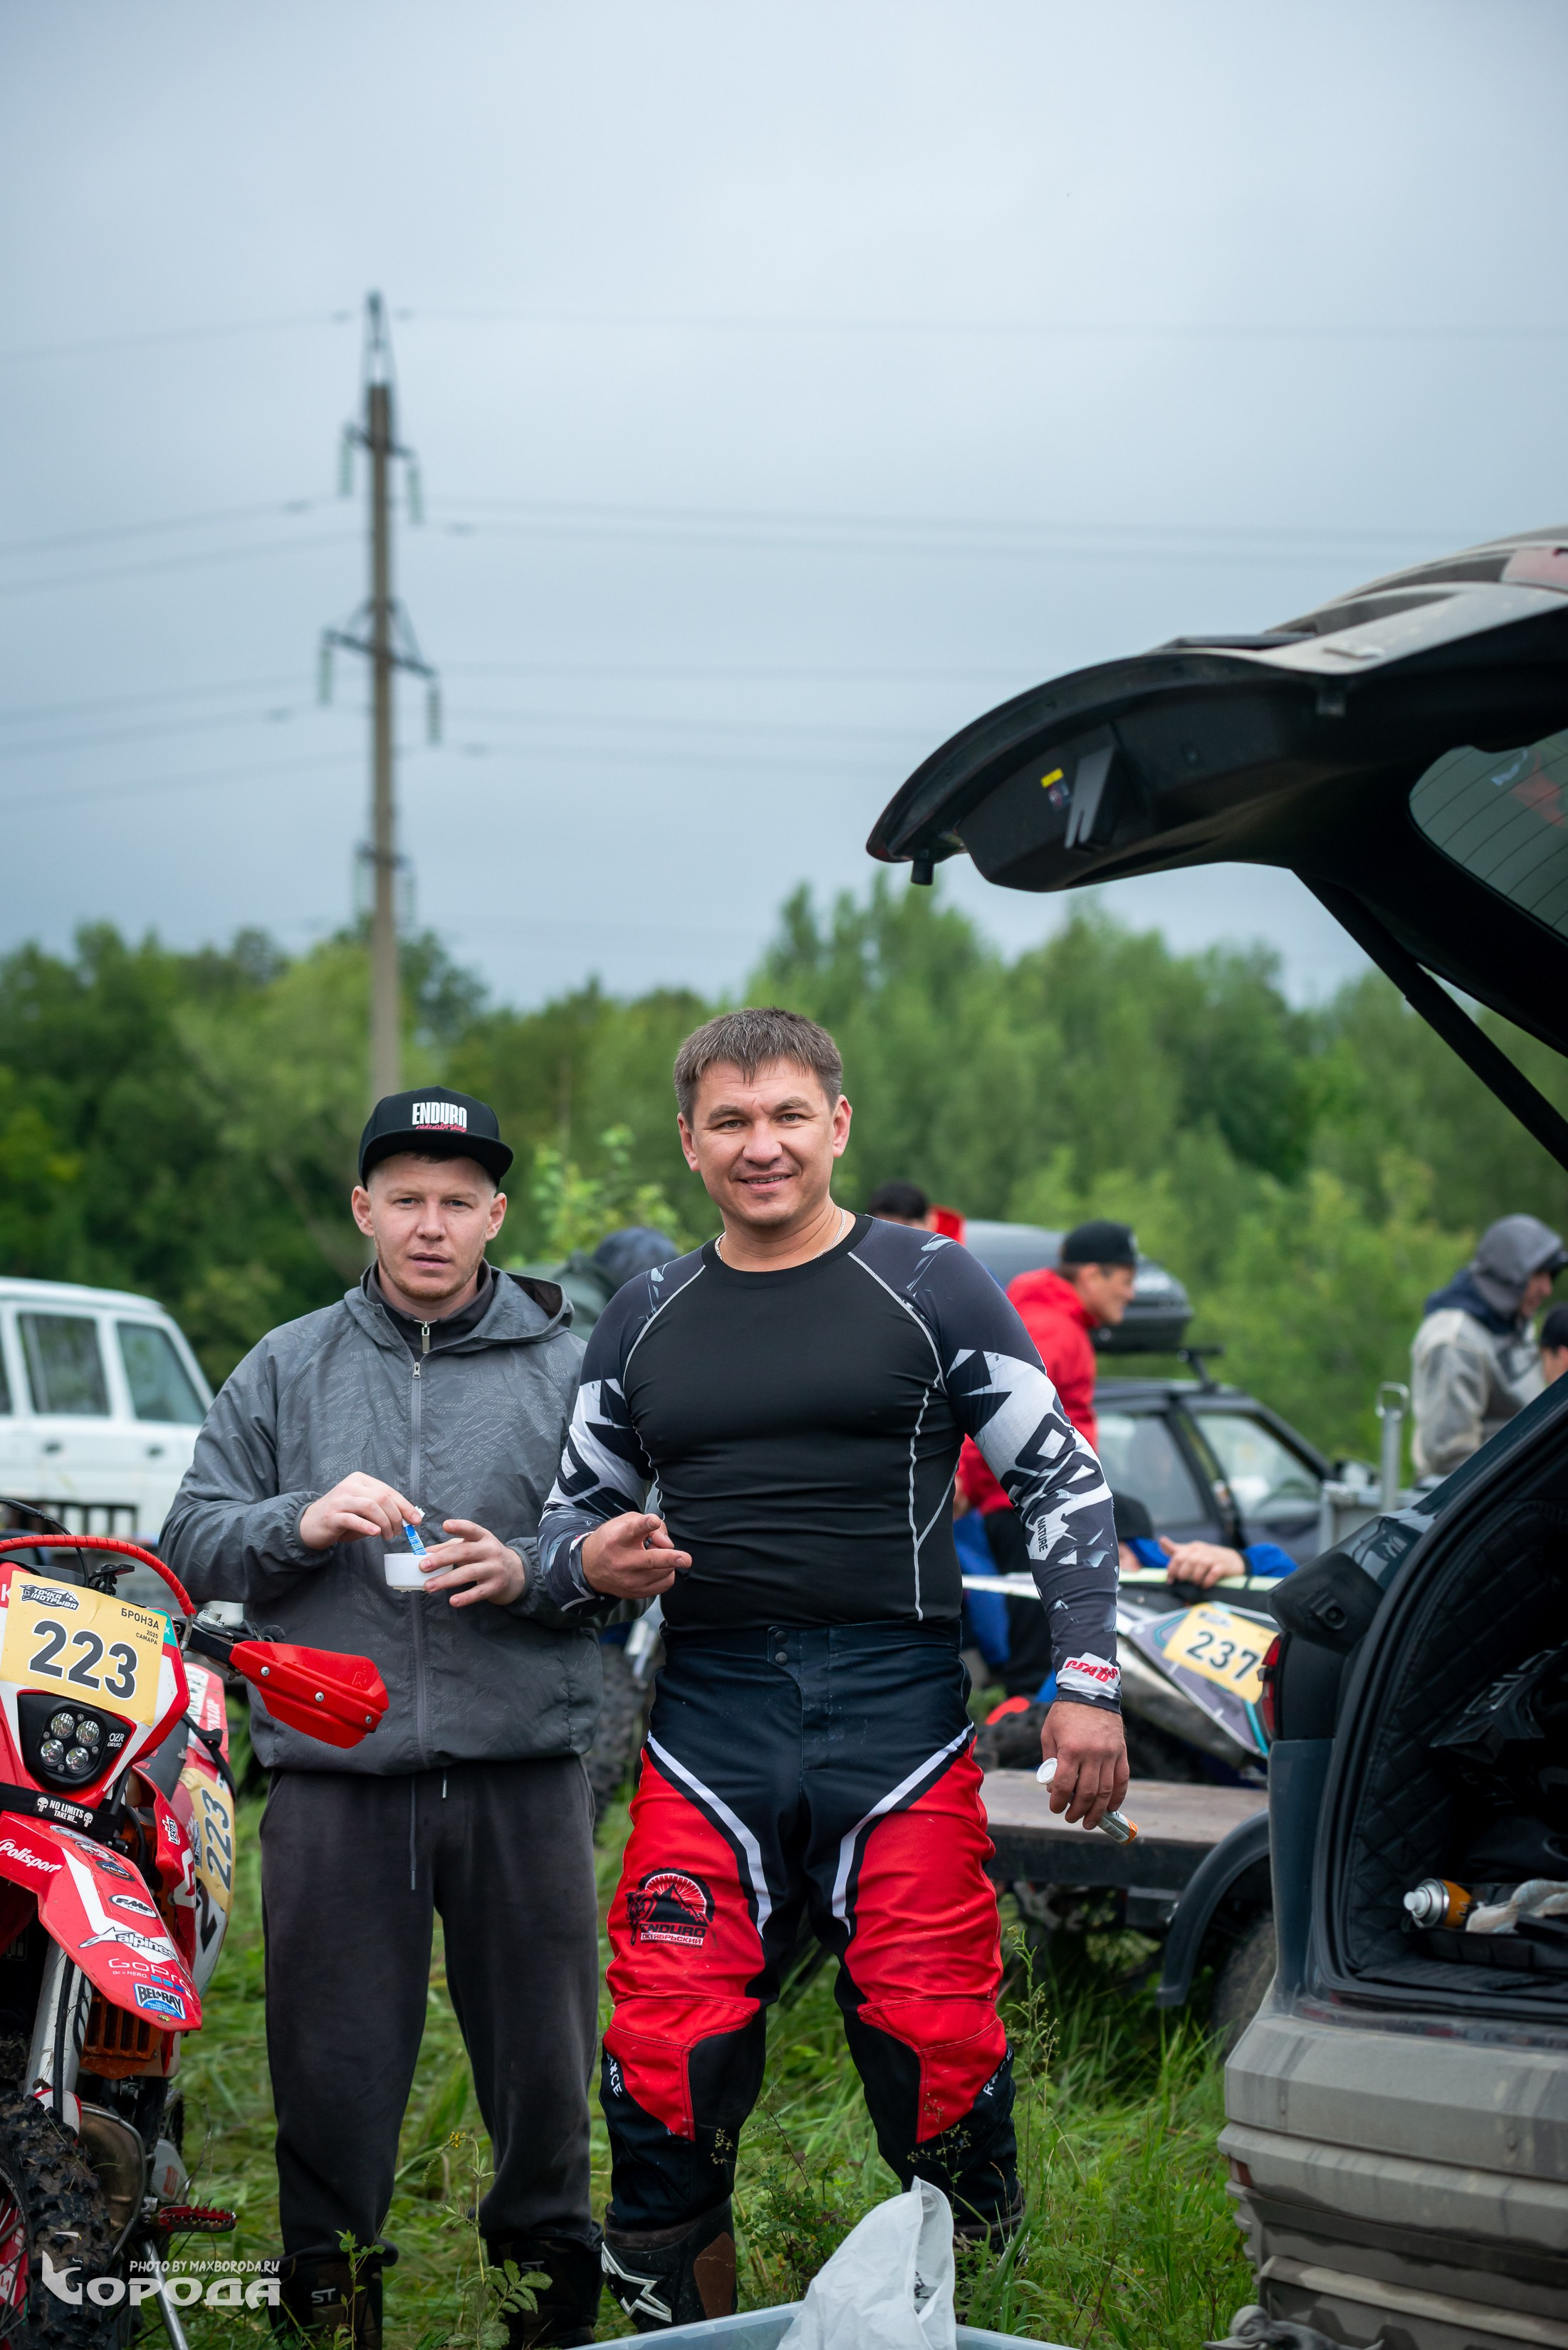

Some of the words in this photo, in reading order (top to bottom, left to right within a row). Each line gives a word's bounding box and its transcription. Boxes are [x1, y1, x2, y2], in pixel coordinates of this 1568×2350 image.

[412, 1102, 467, 1129] ENDURO
[1037, 1517, 1048, 1552] NATURE
[33, 1588, 62, 1600] ТОЧКА
[121, 1607, 160, 1630] БРОНЗА
[136, 1632, 158, 1646] САМАРА
[146, 1630, 159, 1639] 2025
[28, 1619, 138, 1699] 223
[1186, 1631, 1260, 1679] 237
[109, 1733, 125, 1743] OZR
[49, 1800, 61, 1810] NO
[61, 1803, 84, 1819] LIMITS
[53, 1810, 68, 1820] TAKE
[202, 1788, 232, 1891] 223
[115, 1897, 153, 1913] FMF
[640, 1923, 706, 1938] ENDURO
[108, 1958, 191, 1993] GoPro
[310, 2287, 336, 2304] ST
